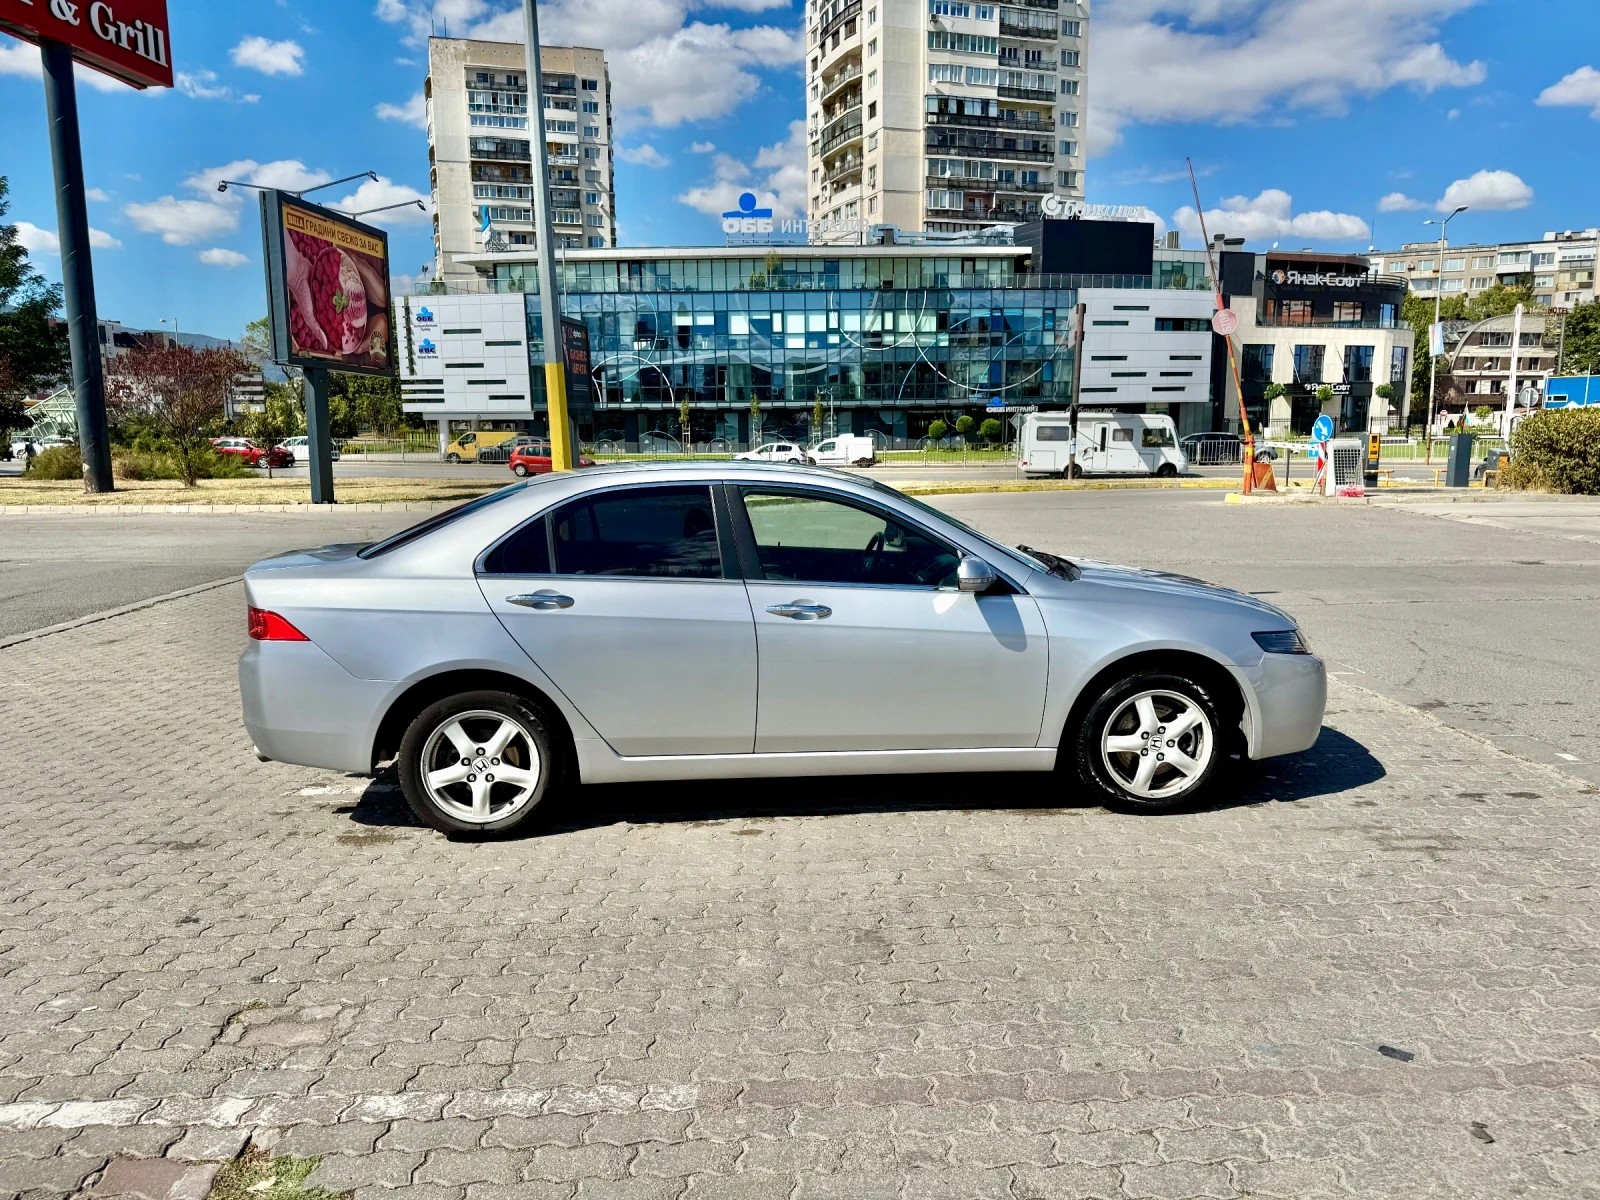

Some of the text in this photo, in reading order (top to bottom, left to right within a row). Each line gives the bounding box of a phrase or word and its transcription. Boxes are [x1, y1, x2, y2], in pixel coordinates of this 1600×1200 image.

[50, 0, 168, 68] & Grill
[305, 219, 336, 239] ГРАДИНИ
[337, 231, 359, 247] СВЕЖО
[359, 239, 367, 250] ЗА
[367, 242, 379, 253] ВАС
[722, 218, 774, 233] ОББ
[1219, 312, 1232, 332] STOP
